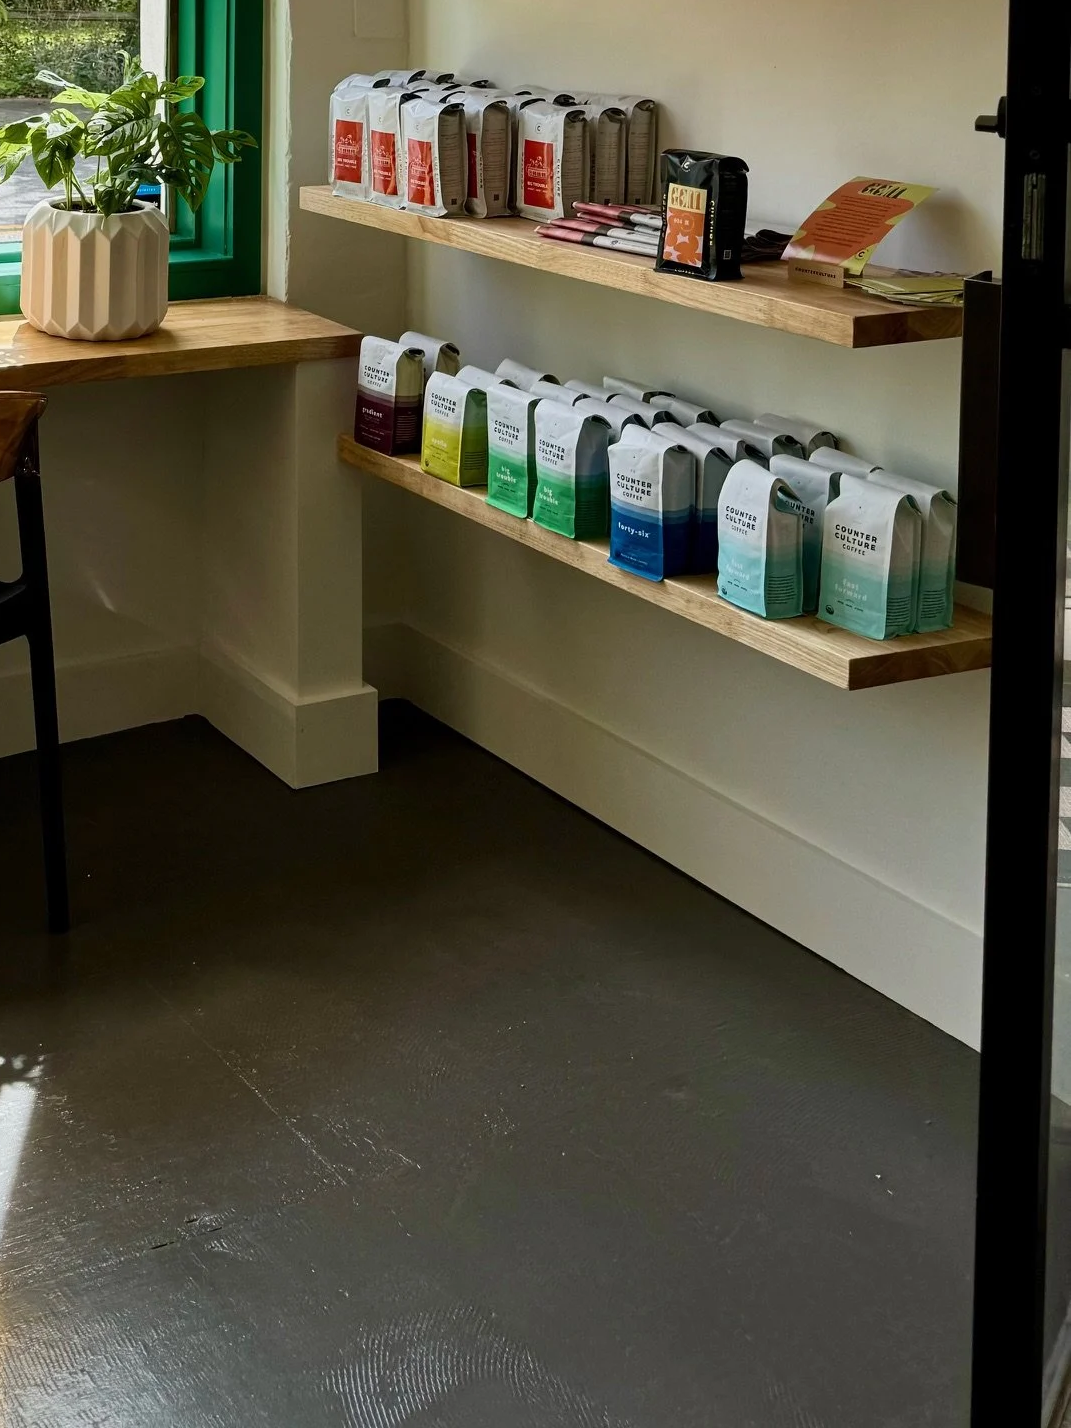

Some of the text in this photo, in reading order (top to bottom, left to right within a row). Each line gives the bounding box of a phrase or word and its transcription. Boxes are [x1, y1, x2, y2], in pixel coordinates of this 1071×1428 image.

[364, 365, 390, 377] COUNTER
[364, 371, 388, 383] CULTURE
[431, 393, 457, 407] COUNTER
[431, 399, 456, 413] CULTURE
[495, 420, 520, 433] COUNTER
[494, 427, 519, 441] CULTURE
[539, 439, 565, 453] COUNTER
[539, 446, 565, 461] CULTURE
[617, 473, 652, 489] COUNTER
[617, 480, 652, 497] CULTURE
[622, 491, 643, 501] COFFEE
[726, 506, 757, 522] COUNTER
[785, 501, 815, 517] OUNTER
[725, 514, 756, 531] CULTURE
[618, 521, 649, 539] forty-six
[835, 524, 878, 544] COUNTER
[834, 532, 876, 551] CULTURE
[842, 543, 866, 556] COFFEE
